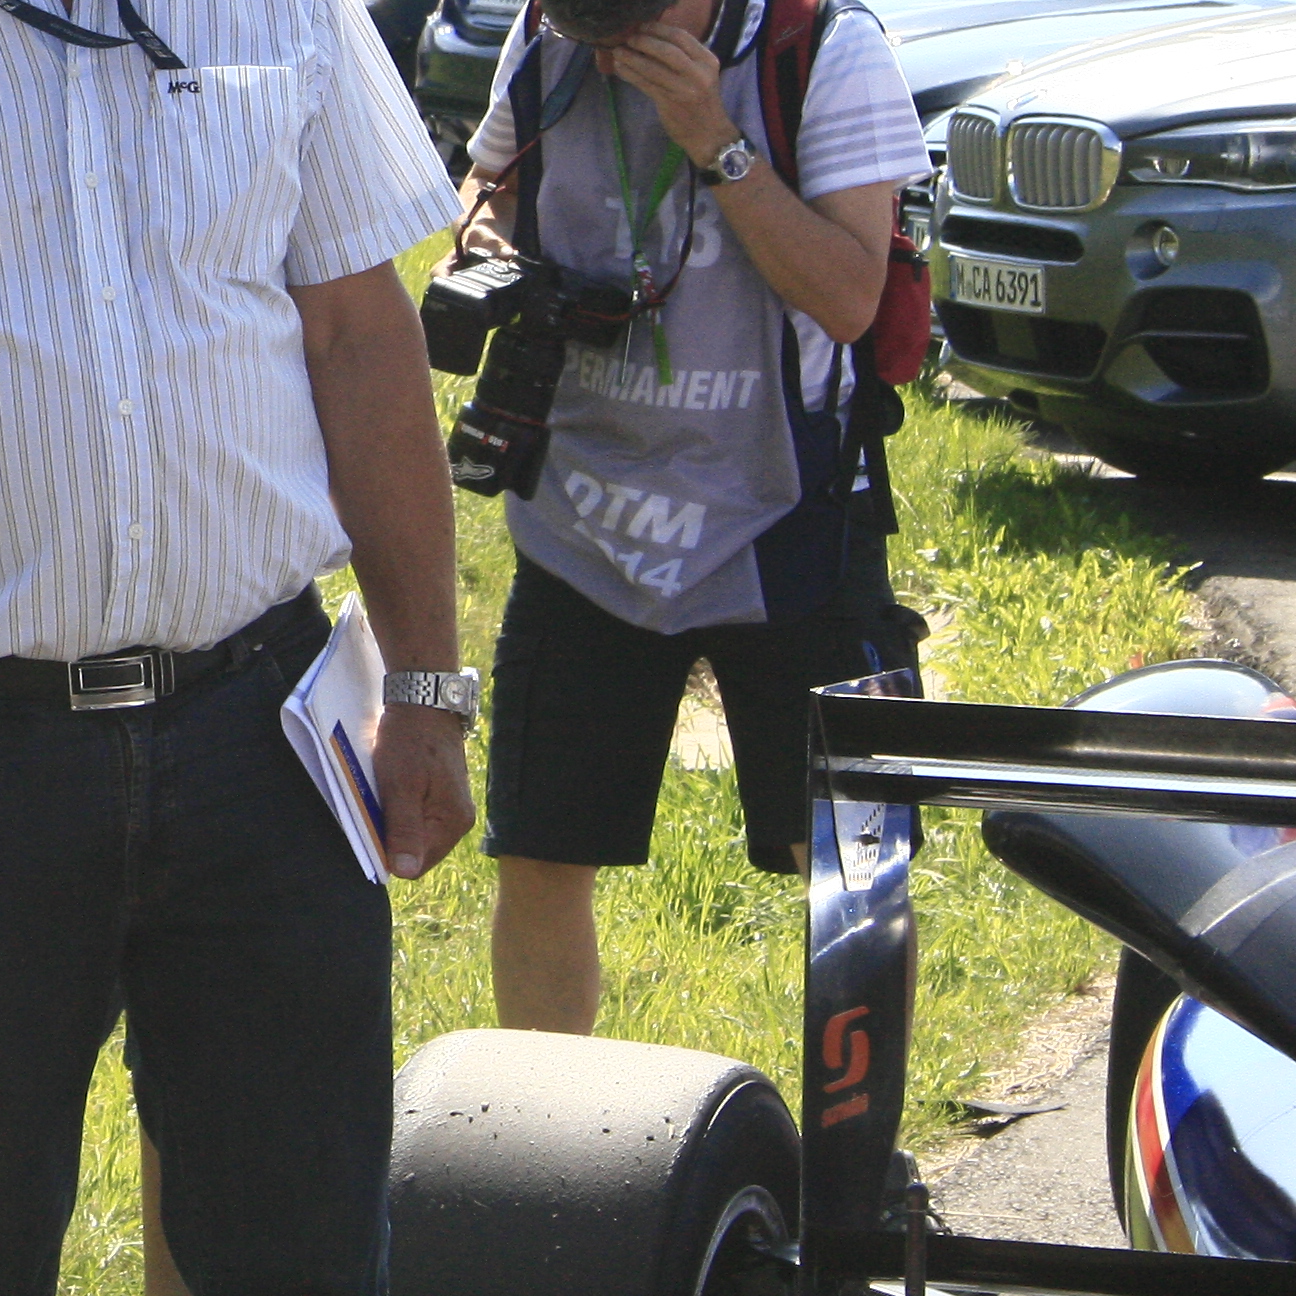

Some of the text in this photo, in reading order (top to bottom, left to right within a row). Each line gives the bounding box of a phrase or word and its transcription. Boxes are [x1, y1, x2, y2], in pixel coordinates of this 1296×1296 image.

[972, 265, 991, 302] CA
[996, 269, 1042, 307] 6391
[564, 470, 707, 549] DTM
